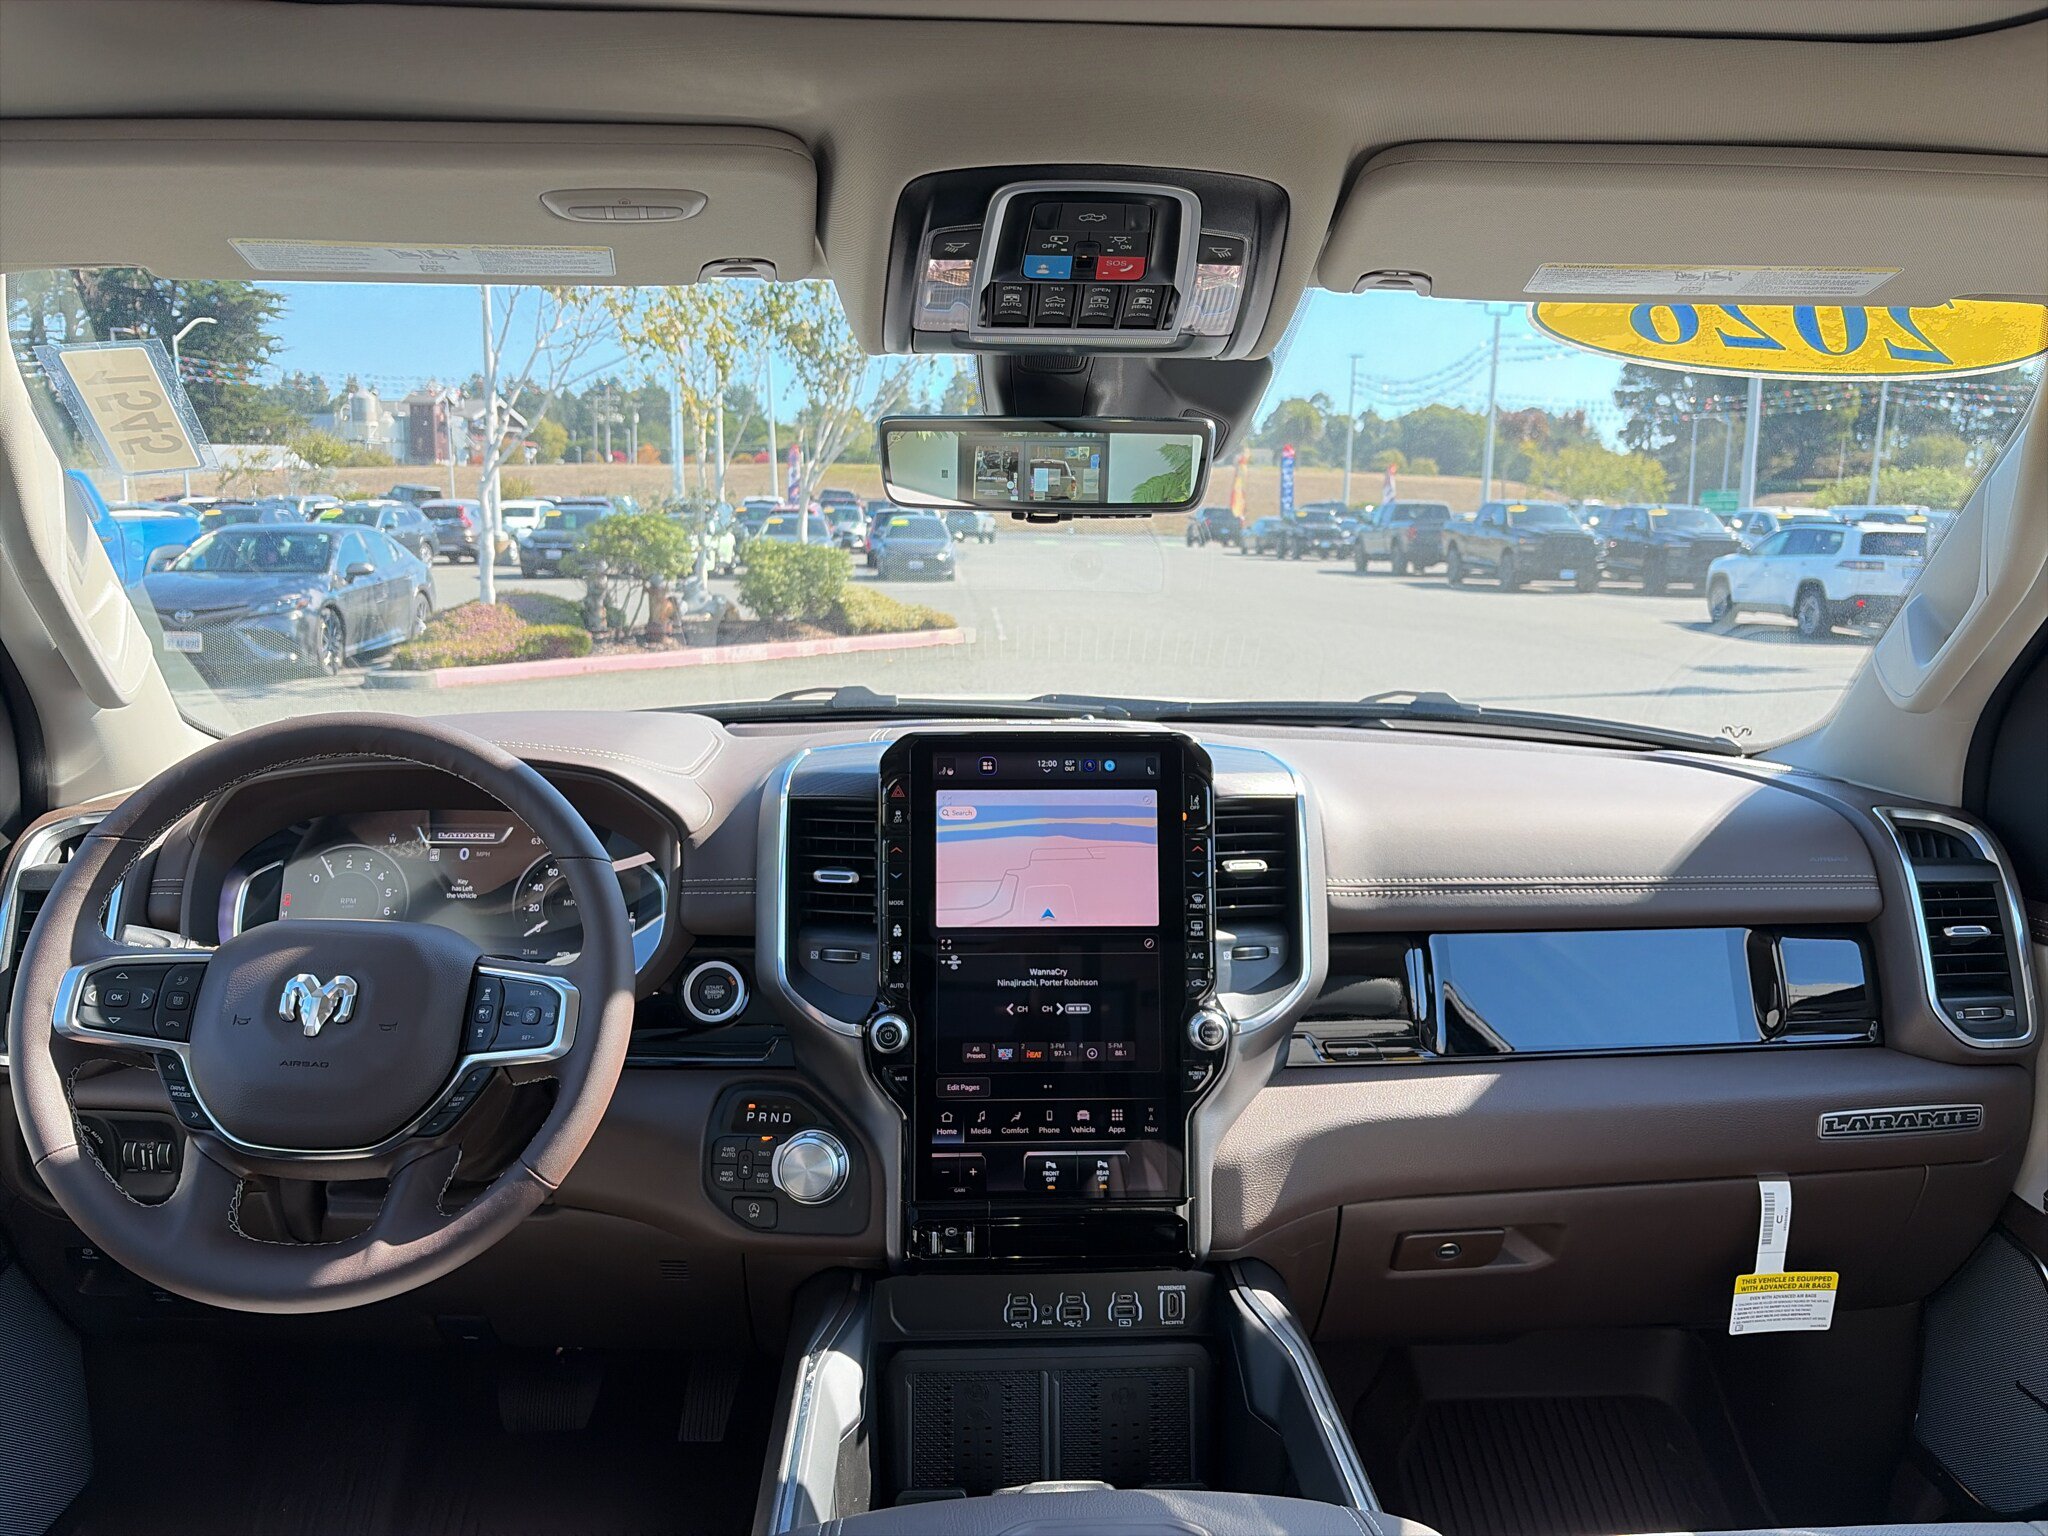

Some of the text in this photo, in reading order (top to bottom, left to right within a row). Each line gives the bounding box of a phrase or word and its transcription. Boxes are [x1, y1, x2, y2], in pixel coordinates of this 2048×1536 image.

[1037, 760, 1057, 768] 12:00
[389, 836, 397, 844] W
[459, 848, 470, 861] 0
[346, 859, 353, 869] 2
[364, 862, 371, 871] 3
[547, 868, 558, 876] 60
[312, 874, 320, 884] 0
[378, 872, 384, 881] 4
[457, 878, 468, 886] Key
[532, 884, 543, 892] 40
[385, 888, 392, 897] 5
[383, 907, 390, 916] 6
[528, 904, 540, 912] 20
[1029, 967, 1067, 977] WannaCry
[997, 978, 1098, 987] Ninajirachi, Porter Robinson
[110, 993, 123, 1001] OK
[1016, 1005, 1028, 1013] CH
[1041, 1005, 1053, 1013] CH
[1026, 1051, 1042, 1059] HEAT
[279, 1059, 330, 1069] AIRBAG
[169, 1084, 186, 1092] DRIVE
[960, 1084, 980, 1092] Pages
[1824, 1108, 1981, 1135] LARAMIE
[1108, 1126, 1126, 1134] Apps
[1758, 1276, 1787, 1284] VEHICLE
